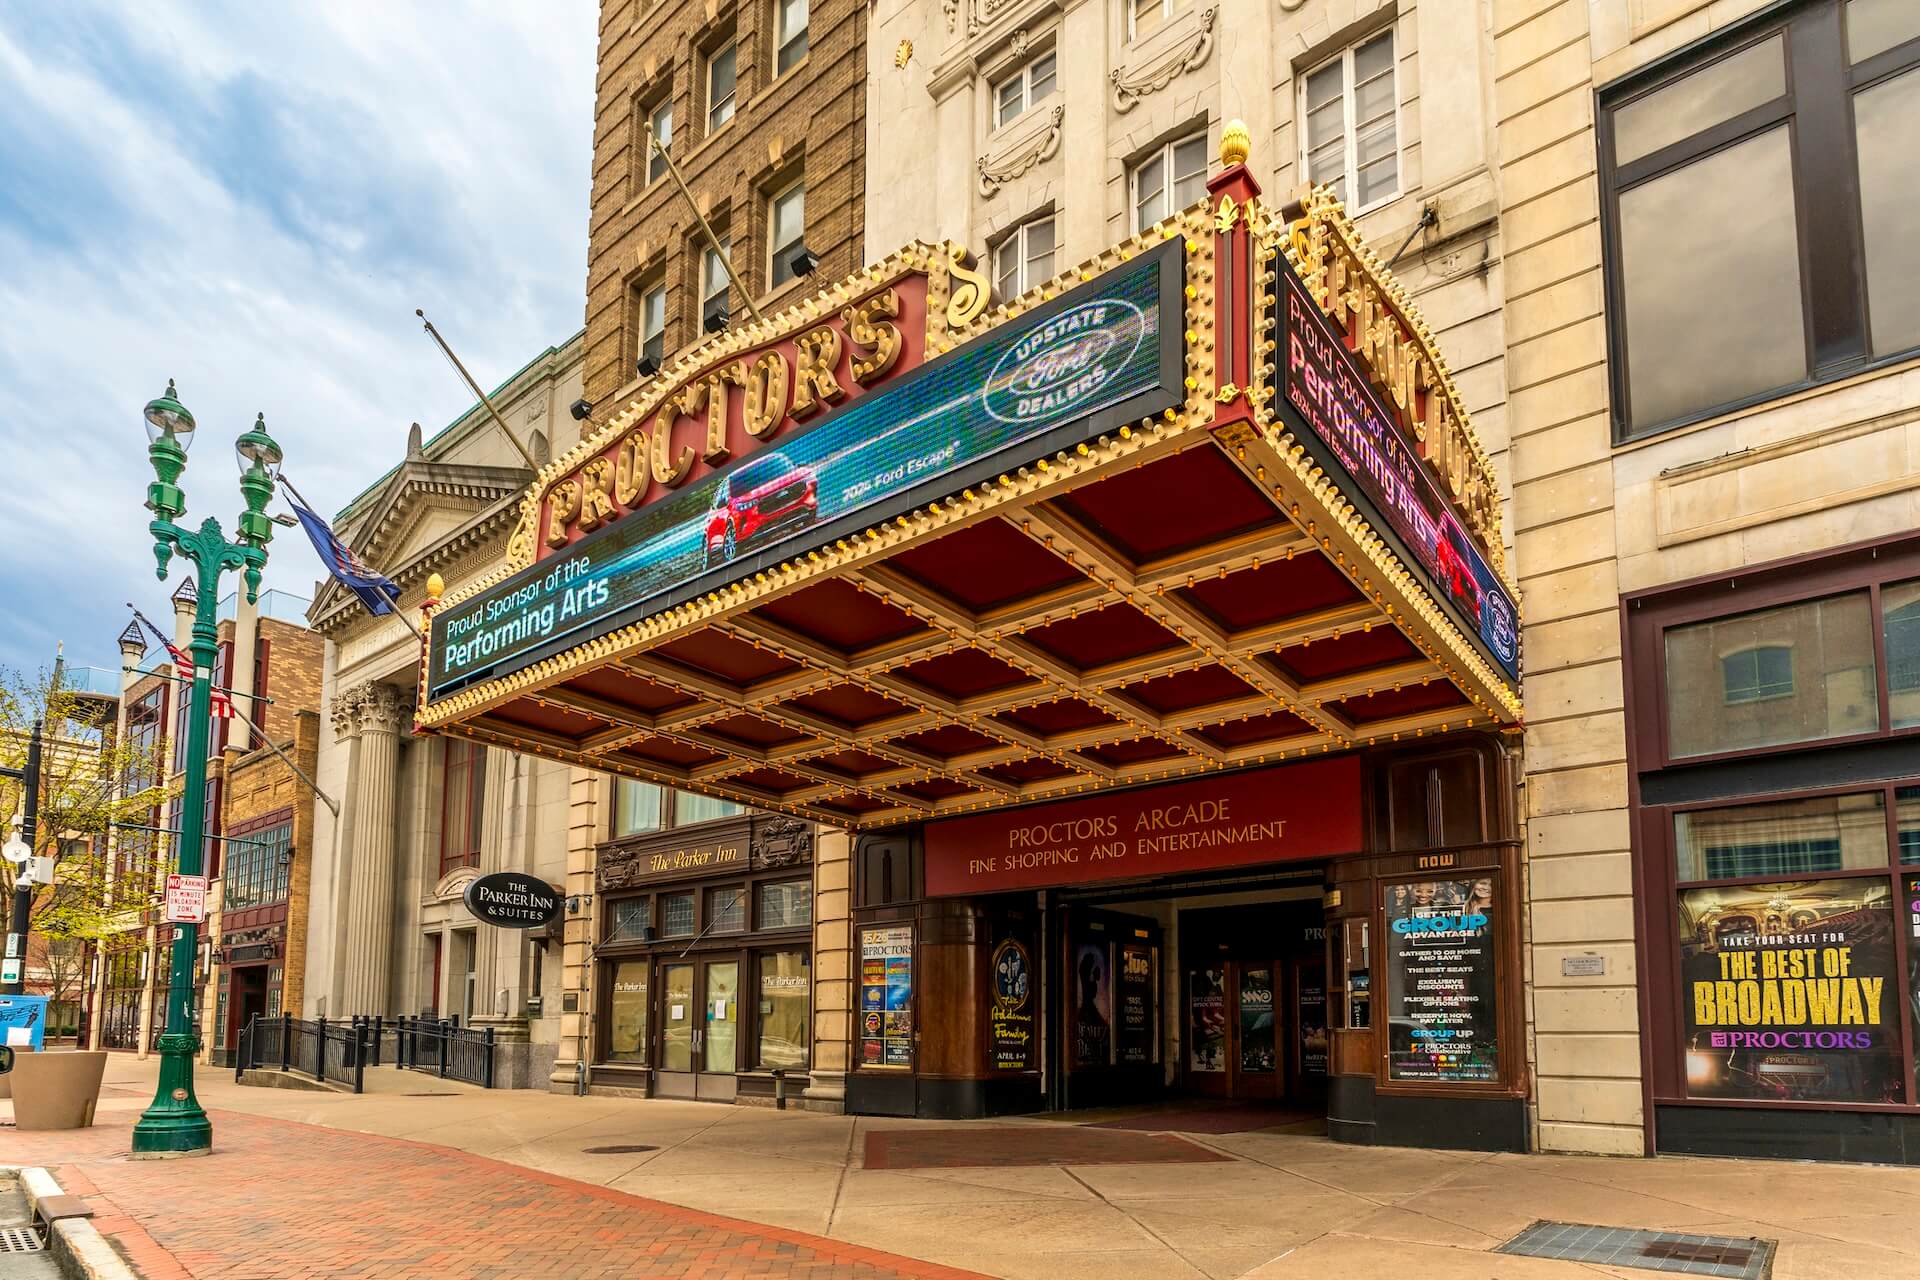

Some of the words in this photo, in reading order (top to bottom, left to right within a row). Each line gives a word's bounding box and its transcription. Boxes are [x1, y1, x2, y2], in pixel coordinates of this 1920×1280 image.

[1016, 306, 1107, 362] UPSTATE
[1026, 338, 1108, 390] Ford
[1017, 364, 1107, 417] DEALERS
[1291, 293, 1333, 375] Proud
[1335, 361, 1384, 443] Sponsor
[1386, 437, 1397, 458] of
[1399, 450, 1415, 487] the
[544, 287, 902, 549] PROCTORS
[1290, 332, 1394, 504] Performing
[1399, 483, 1428, 541] Arts
[875, 464, 904, 487] Ford
[446, 604, 484, 641] Proud
[486, 579, 542, 622] Sponsor
[545, 564, 562, 591] of
[564, 556, 590, 582] the
[444, 602, 555, 673] Performing
[559, 577, 610, 622] Arts
[1009, 815, 1118, 848] PROCTORS
[1135, 799, 1231, 833] ARCADE
[651, 854, 671, 871] The
[674, 849, 712, 868] Parker
[716, 845, 737, 862] Inn
[969, 857, 996, 874] FINE
[1004, 848, 1079, 871] SHOPPING
[1090, 842, 1127, 860] AND
[1138, 820, 1287, 855] ENTERTAINMENT
[169, 877, 180, 888] NO
[480, 886, 529, 906] PARKER
[530, 893, 553, 909] INN
[508, 882, 527, 893] THE
[488, 906, 497, 916] &
[498, 907, 544, 920] SUITES
[1392, 914, 1488, 933] GROUP
[868, 944, 913, 957] PROCTORS
[1404, 930, 1475, 939] ADVANTAGE
[1723, 936, 1749, 947] TAKE
[1755, 935, 1783, 946] YOUR
[1788, 934, 1816, 945] SEAT
[1823, 932, 1845, 943] FOR
[1718, 950, 1757, 980] THE
[1762, 948, 1817, 979] BEST
[1822, 947, 1852, 978] OF
[1693, 976, 1884, 1026] BROADWAY
[1730, 1032, 1872, 1049] PROCTORS
